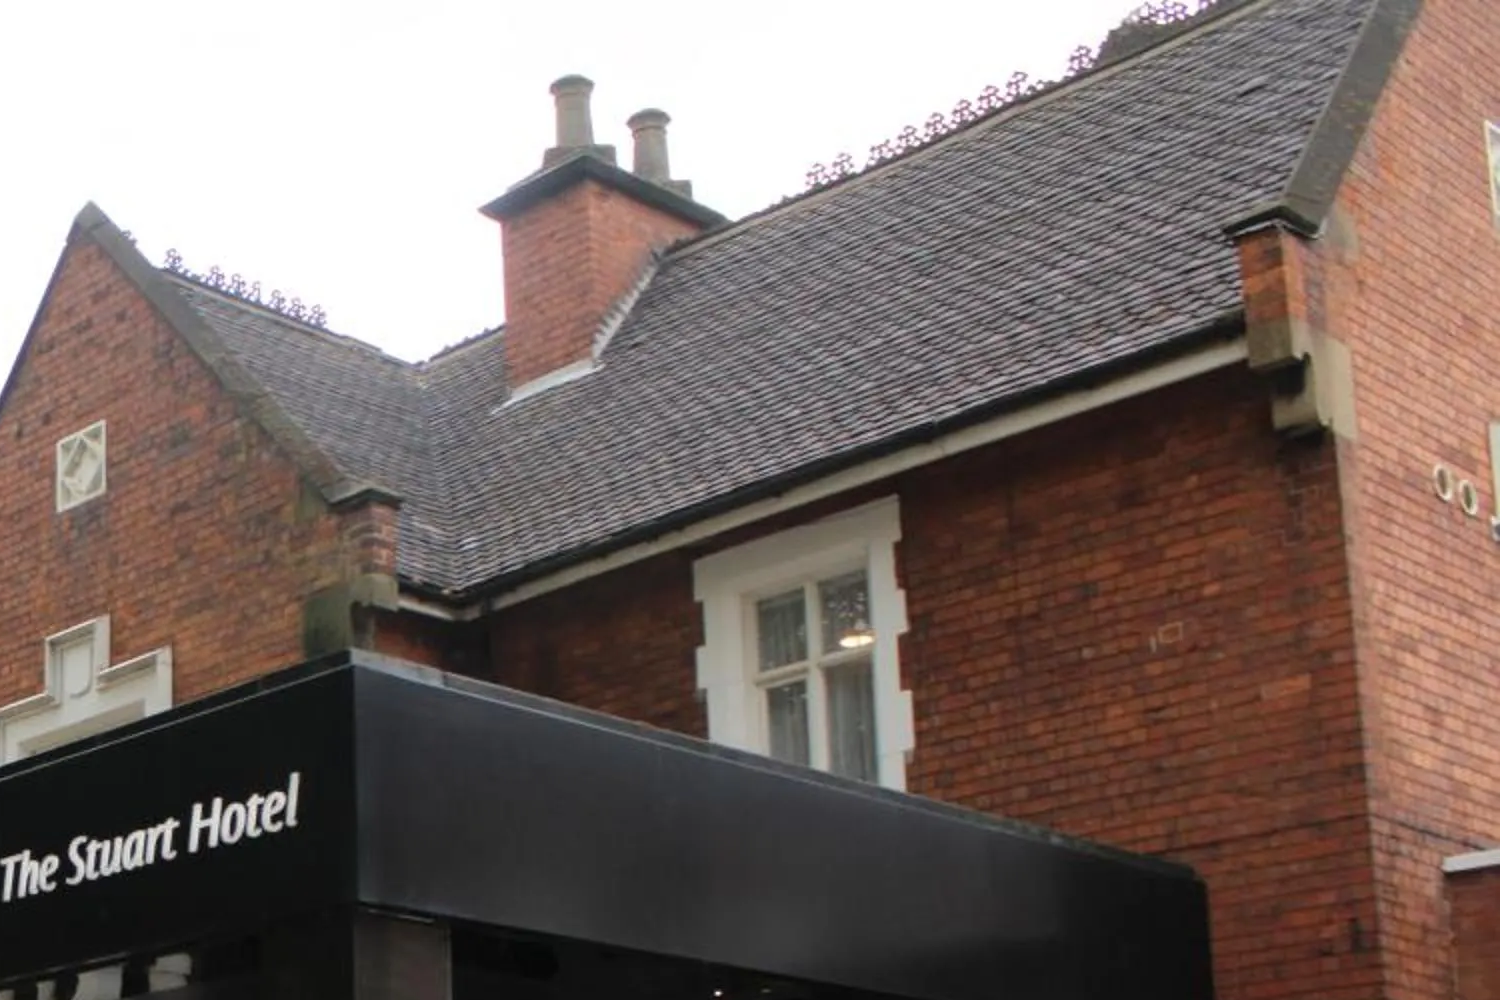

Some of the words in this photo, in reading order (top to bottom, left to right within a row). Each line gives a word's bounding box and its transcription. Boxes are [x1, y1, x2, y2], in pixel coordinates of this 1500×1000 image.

[0, 849, 60, 902] The
[64, 816, 181, 886] Stuart
[187, 770, 301, 854] Hotel
